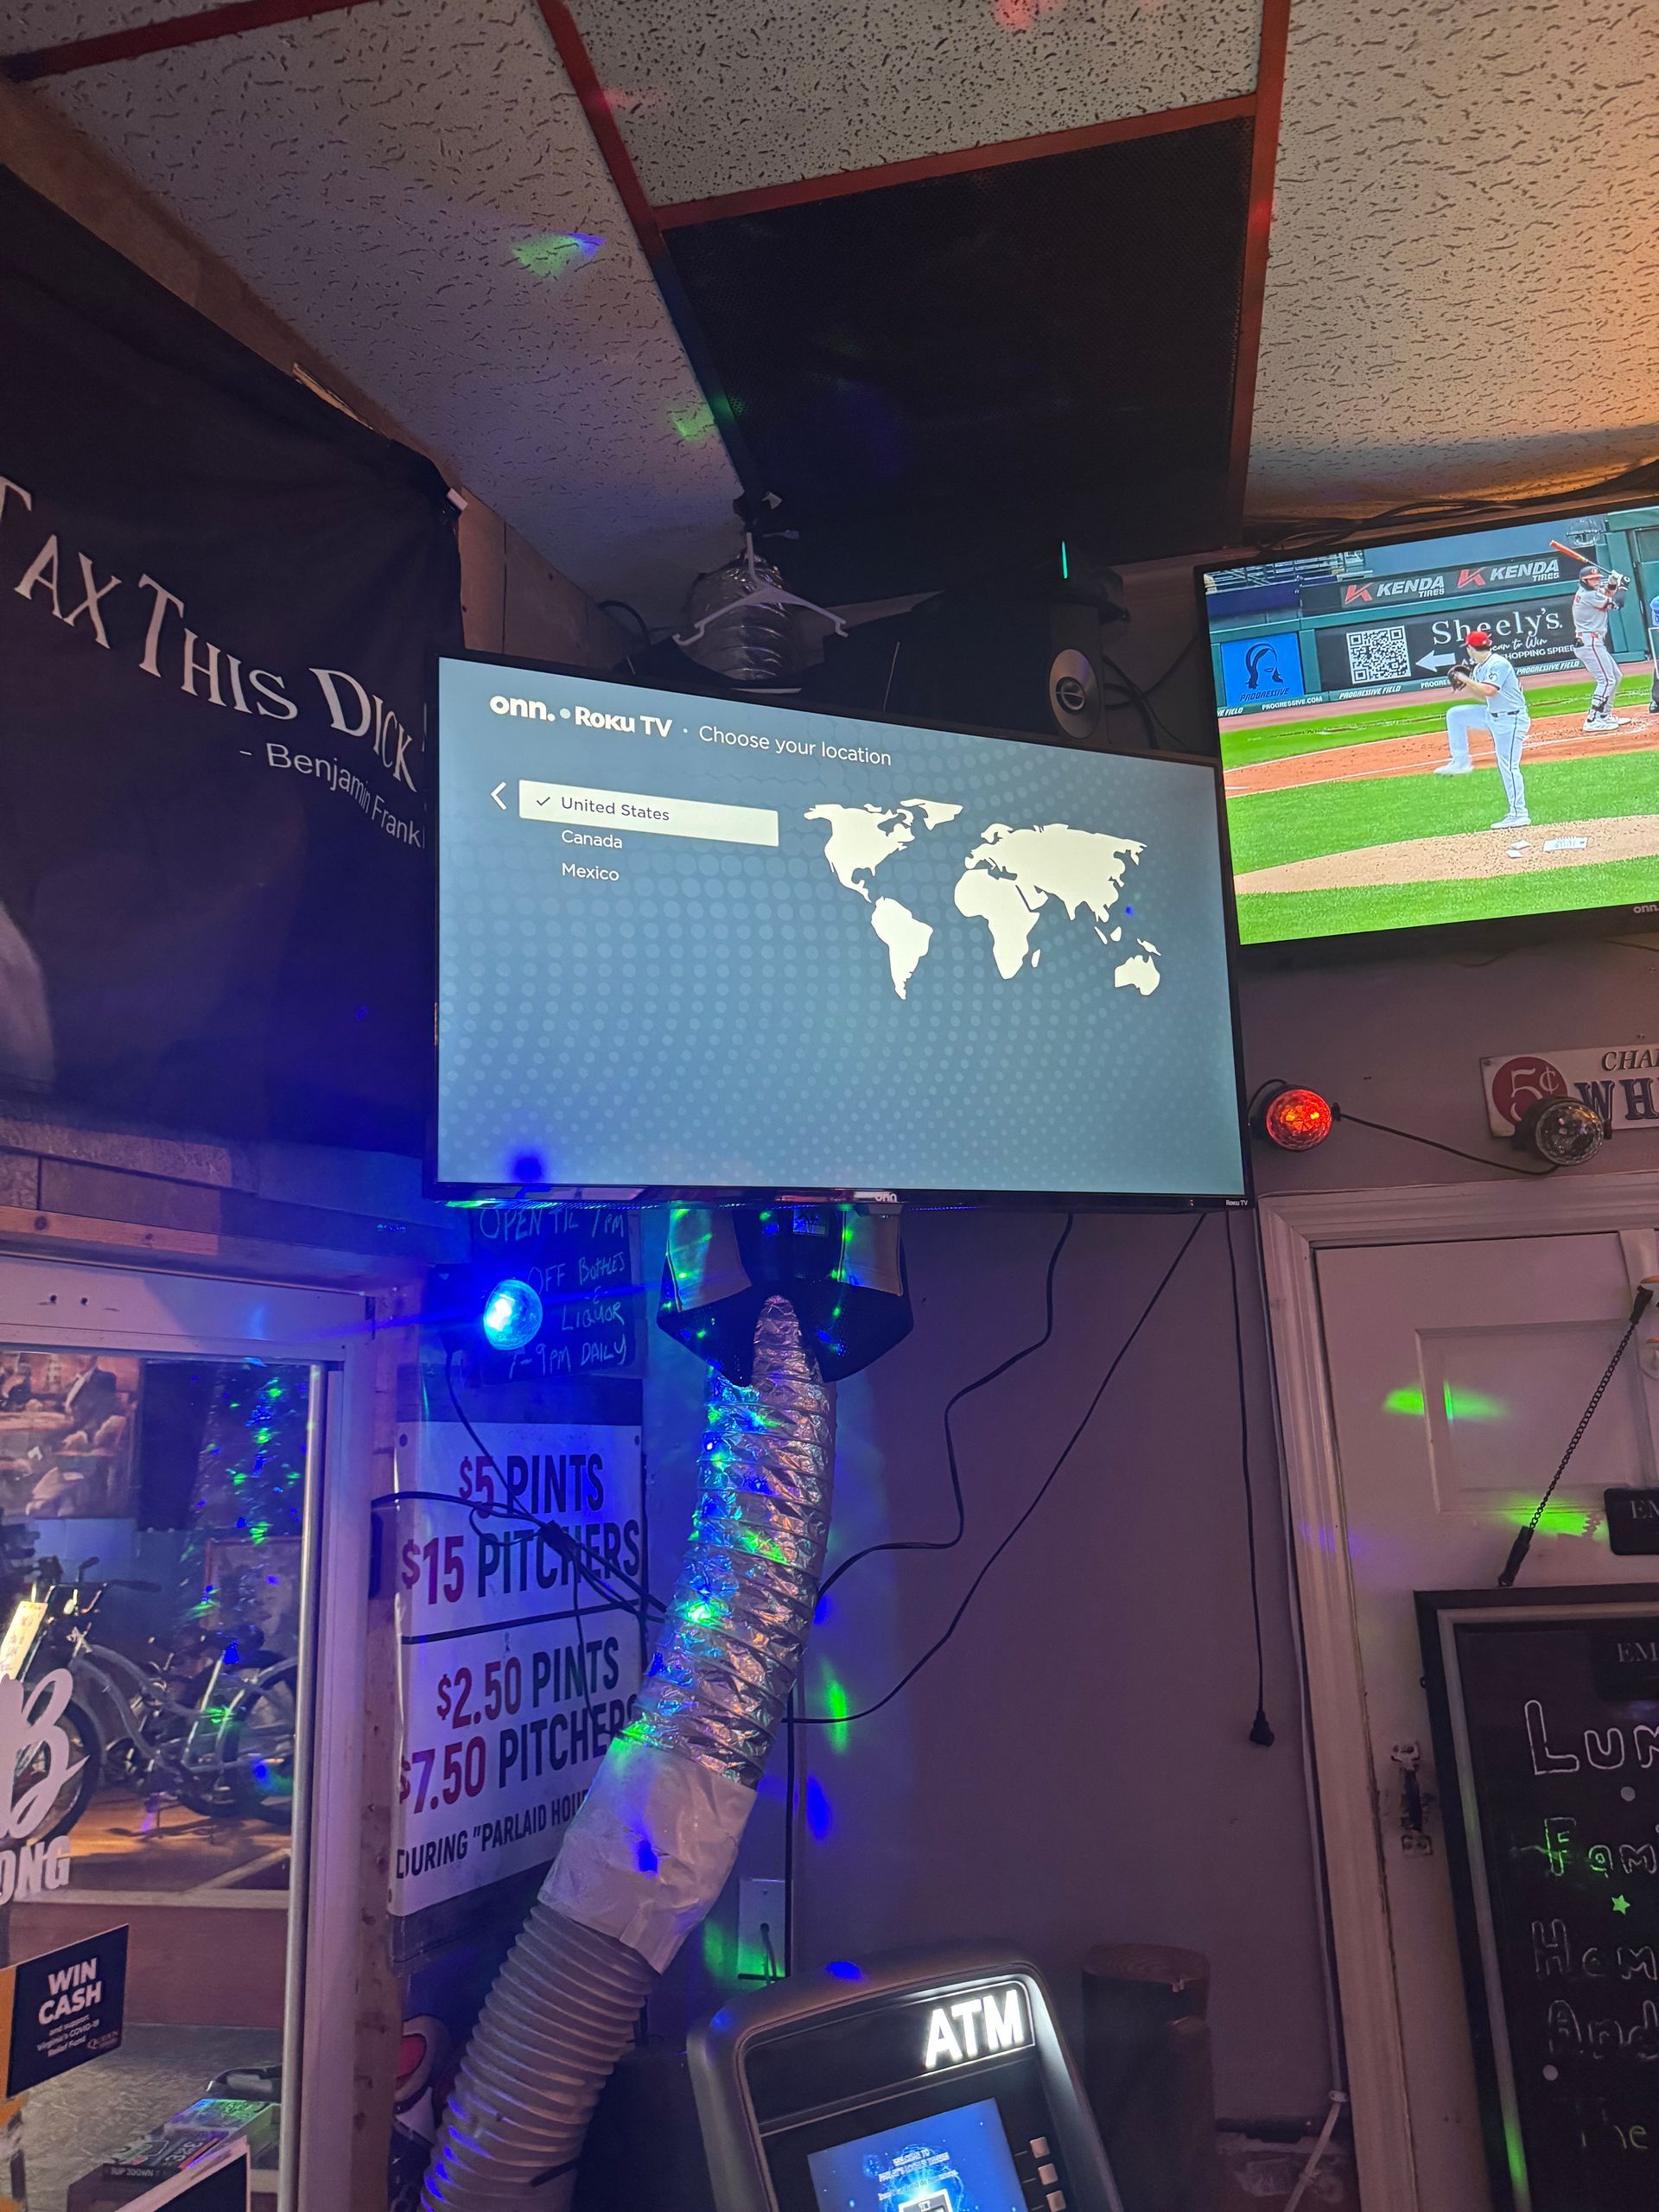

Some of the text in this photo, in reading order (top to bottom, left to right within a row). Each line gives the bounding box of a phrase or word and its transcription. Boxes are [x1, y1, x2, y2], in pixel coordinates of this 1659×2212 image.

[1490, 559, 1560, 582] KENDA
[1532, 572, 1560, 582] TIRES
[1376, 575, 1445, 598] KENDA
[1418, 587, 1446, 598] TIRES
[1503, 648, 1546, 661] HOPPING
[1512, 639, 1523, 650] to
[1526, 635, 1548, 650] Win
[1516, 660, 1580, 675] PROGRESSIVE FIELD
[138, 574, 299, 720] THIS
[308, 667, 418, 793] DICK
[1239, 688, 1290, 702] PROGRESSIVE
[1339, 685, 1402, 700] PROGRESSIVE FIELD
[1262, 696, 1323, 711] PROGRESSIVE.COM
[490, 695, 893, 766] onn. Roku TV Choose your location
[266, 742, 371, 814] Benjamin
[562, 796, 671, 822] United States
[561, 830, 623, 849] Canada
[562, 862, 620, 881] Mexico
[1601, 1048, 1659, 1071] CHA
[1573, 1077, 1659, 1125] WH
[480, 1208, 543, 1242] OPEN
[527, 1264, 566, 1294] OFF
[562, 1301, 625, 1331] LIQUOR
[580, 1333, 627, 1365] DAILY
[458, 1453, 604, 1519] $5 PINTS
[402, 1519, 640, 1605] $15 PITCHERS
[436, 1637, 620, 1729] $2.50 PINTS
[399, 1736, 486, 1815] $7.50
[396, 1789, 589, 1878] DURING "PARLAID HOU
[48, 1957, 97, 1996] WIN
[38, 1980, 102, 2025] CASH
[925, 1989, 1026, 2070] ATM
